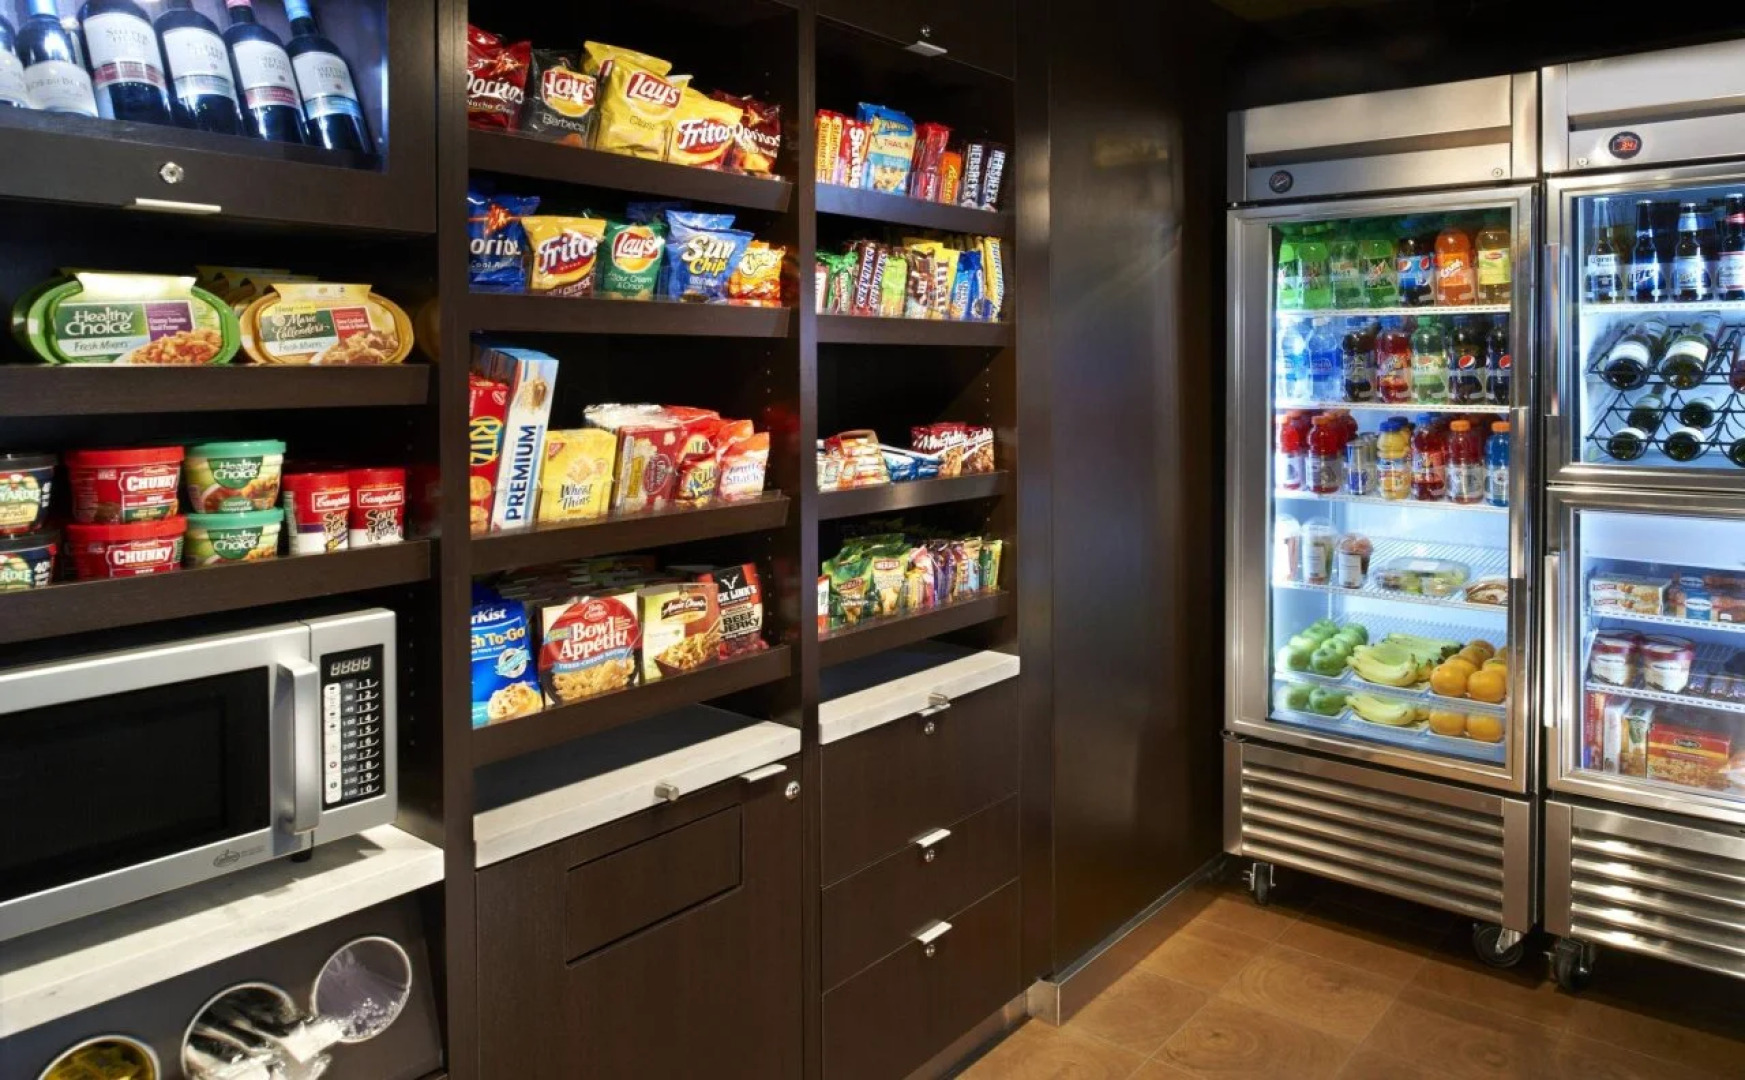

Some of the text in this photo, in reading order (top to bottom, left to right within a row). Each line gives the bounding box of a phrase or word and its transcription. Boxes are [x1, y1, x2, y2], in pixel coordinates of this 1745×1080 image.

[682, 235, 736, 261] Sun
[73, 306, 133, 324] Healthy
[65, 320, 132, 336] Choice
[74, 341, 99, 352] Fresh
[469, 420, 502, 464] RITZ
[213, 468, 258, 480] Choice
[505, 425, 537, 521] PREMIUM
[126, 474, 177, 491] CHUNKY
[561, 483, 593, 498] Wheat
[558, 496, 591, 511] Thins
[213, 540, 258, 551] Choice
[113, 546, 173, 566] CHUNKY
[730, 584, 757, 599] LINK'S
[471, 608, 507, 624] rKist
[723, 611, 755, 625] BEEF
[570, 615, 615, 643] Bowl
[720, 618, 760, 634] JERKY
[483, 627, 526, 646] To-Go
